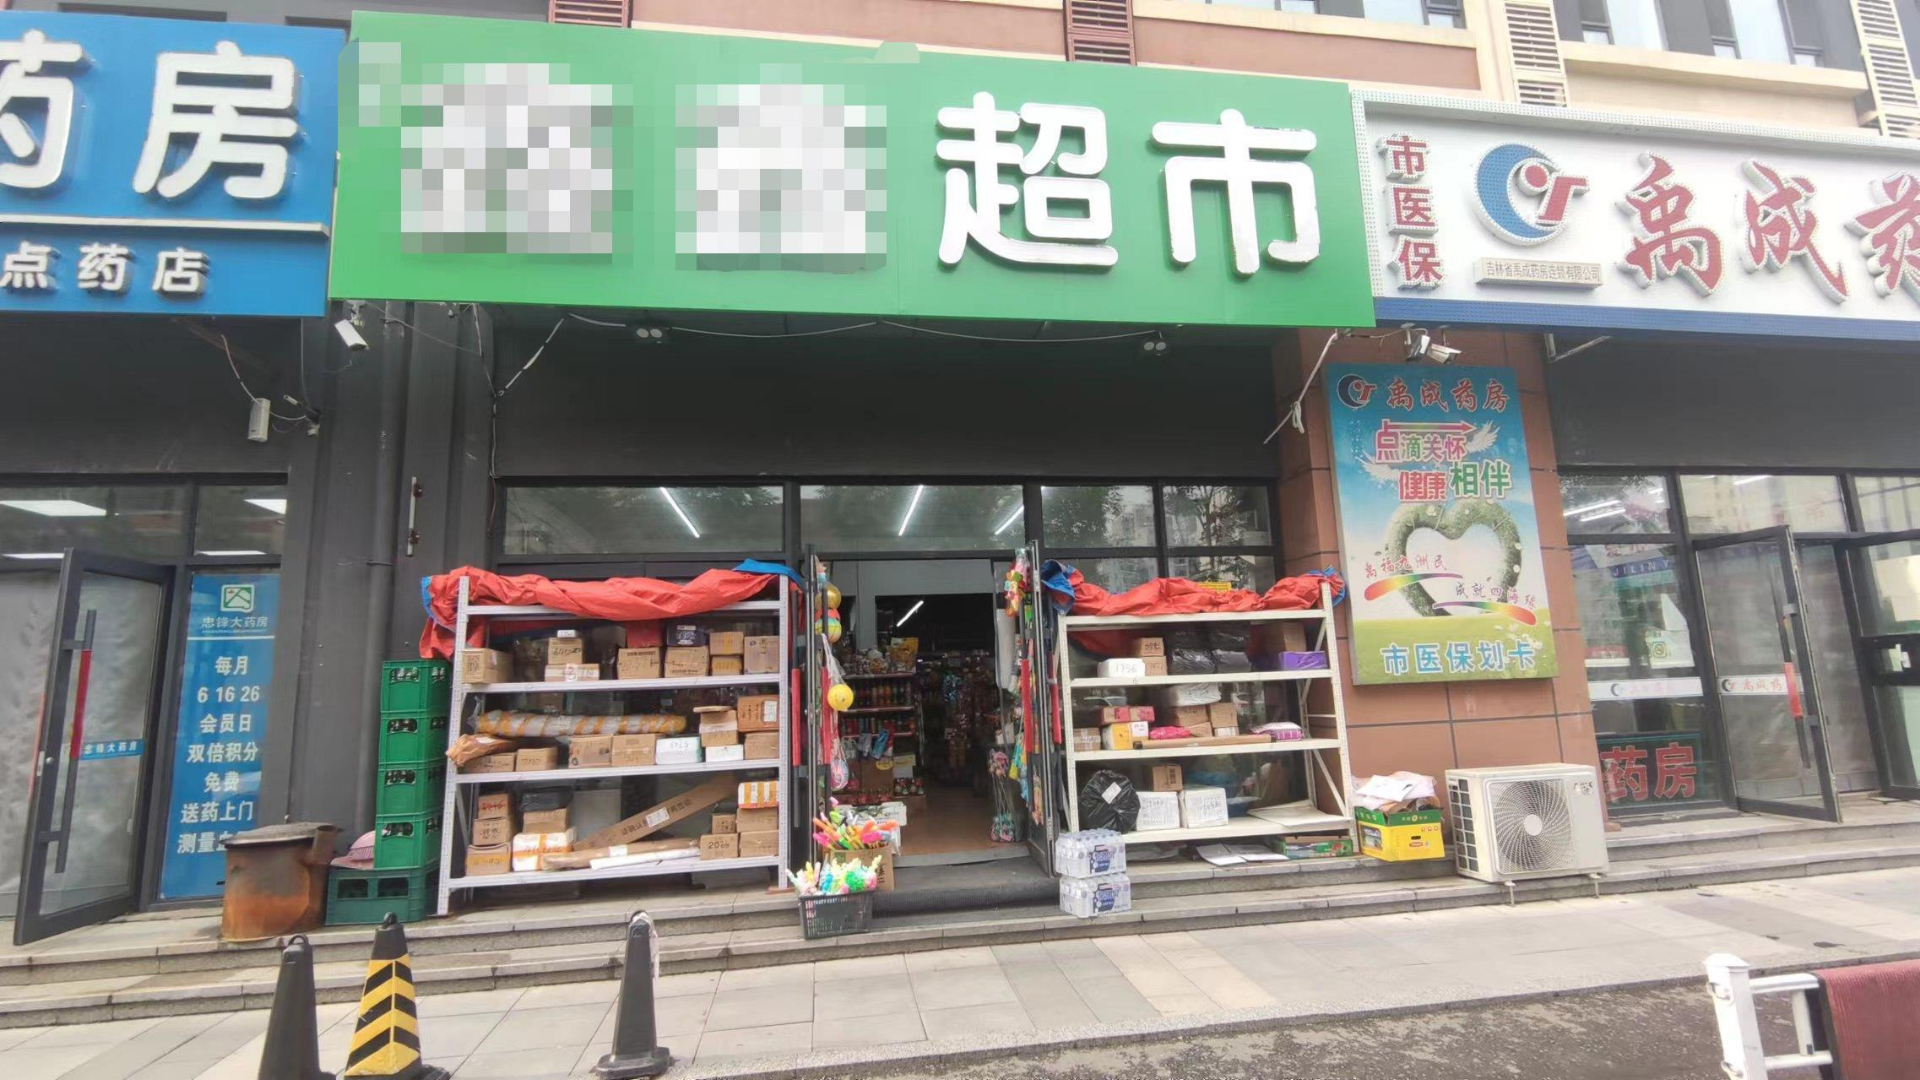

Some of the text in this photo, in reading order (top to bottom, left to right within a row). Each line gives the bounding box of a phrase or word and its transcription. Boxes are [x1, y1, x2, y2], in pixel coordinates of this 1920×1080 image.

[1382, 133, 1444, 285] 市医保
[0, 241, 207, 293] 点药店
[1387, 378, 1510, 413] 禹成药房
[1376, 419, 1468, 463] 点滴关怀
[215, 656, 248, 676] 每月
[1380, 639, 1536, 676] 市医保划卡
[197, 685, 260, 704] 6 16 26
[200, 713, 251, 734] 会员日
[186, 741, 259, 763] 双倍积分
[203, 770, 240, 793] 免费
[1600, 742, 1697, 802] 药房
[180, 801, 254, 823] 送药上门
